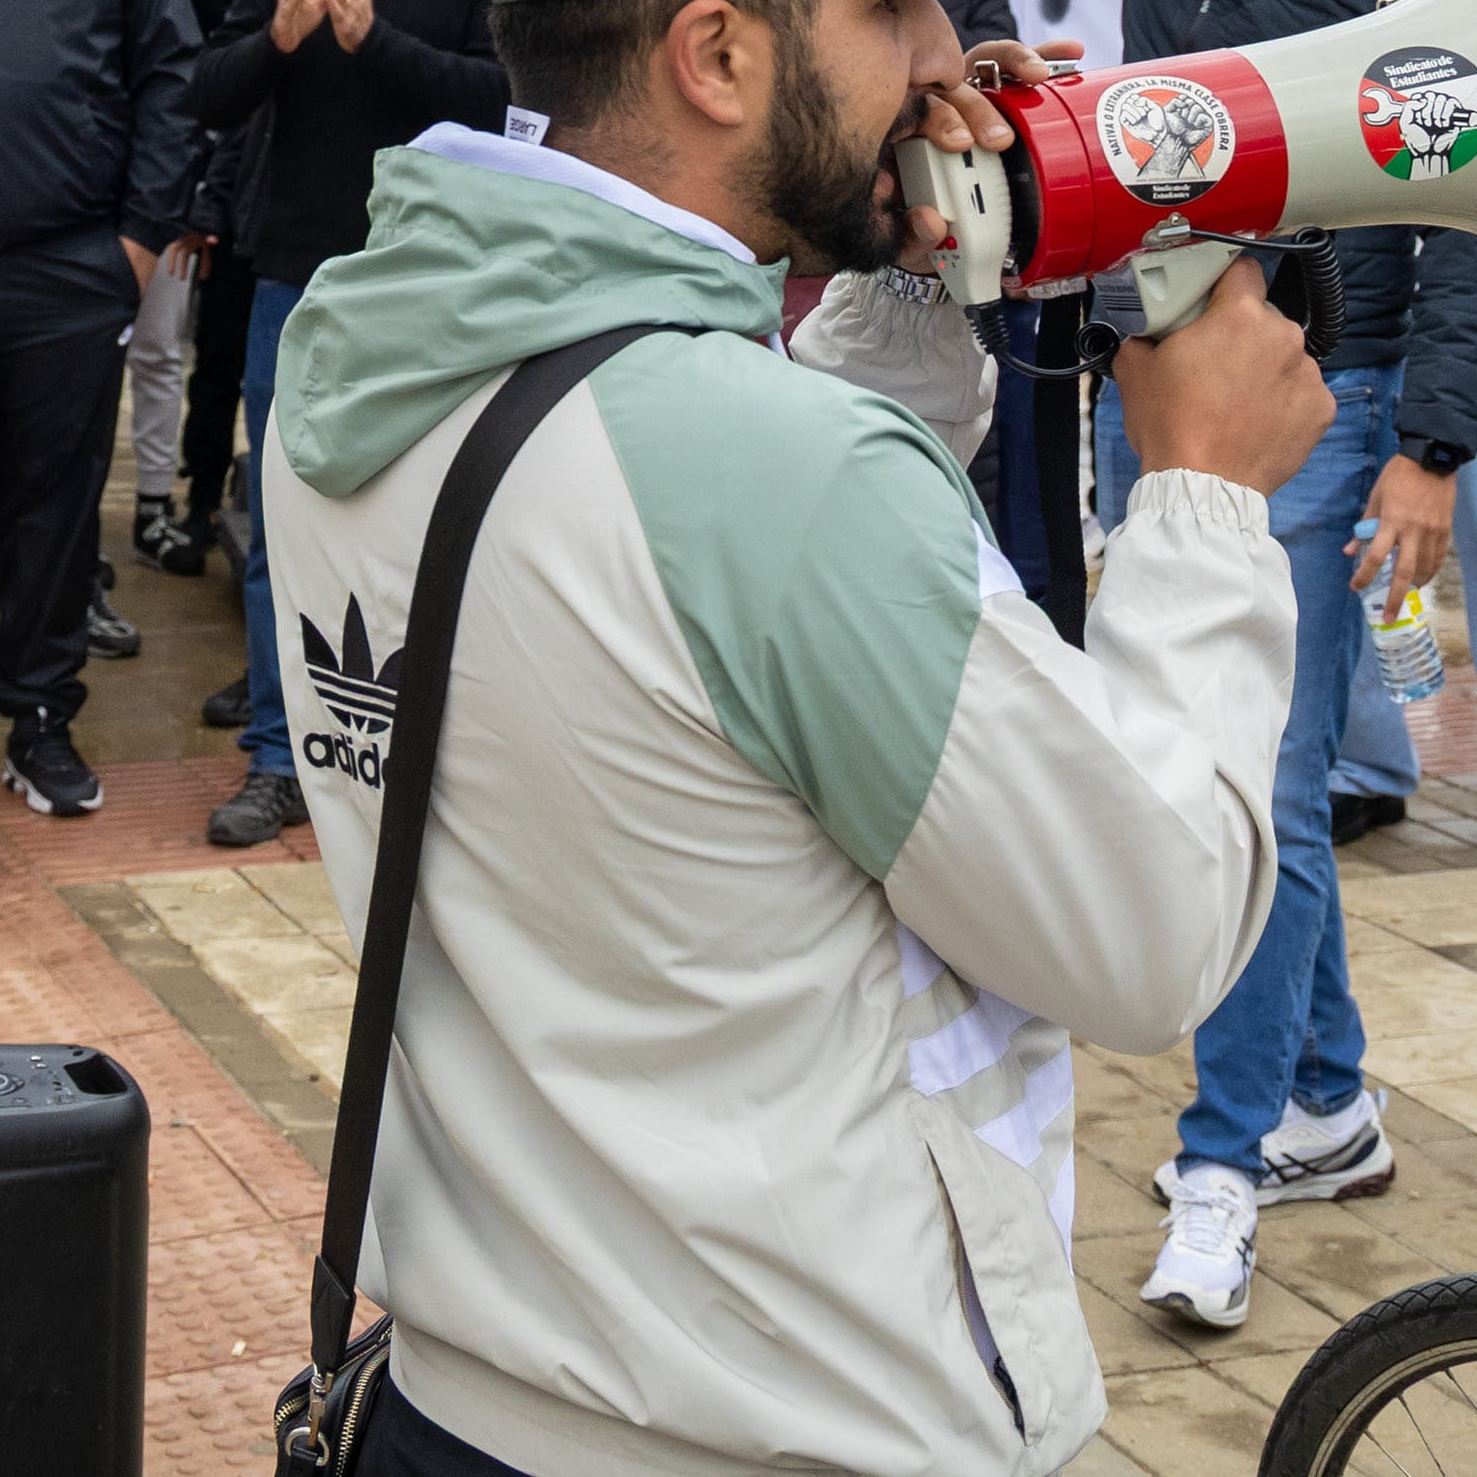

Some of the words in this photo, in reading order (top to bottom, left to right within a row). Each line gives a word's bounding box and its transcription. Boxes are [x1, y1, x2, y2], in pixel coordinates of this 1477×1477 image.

[1389, 66, 1458, 89] Estudiantes
[1194, 88, 1219, 111] CLASE
[1214, 111, 1230, 152] OBRERA
